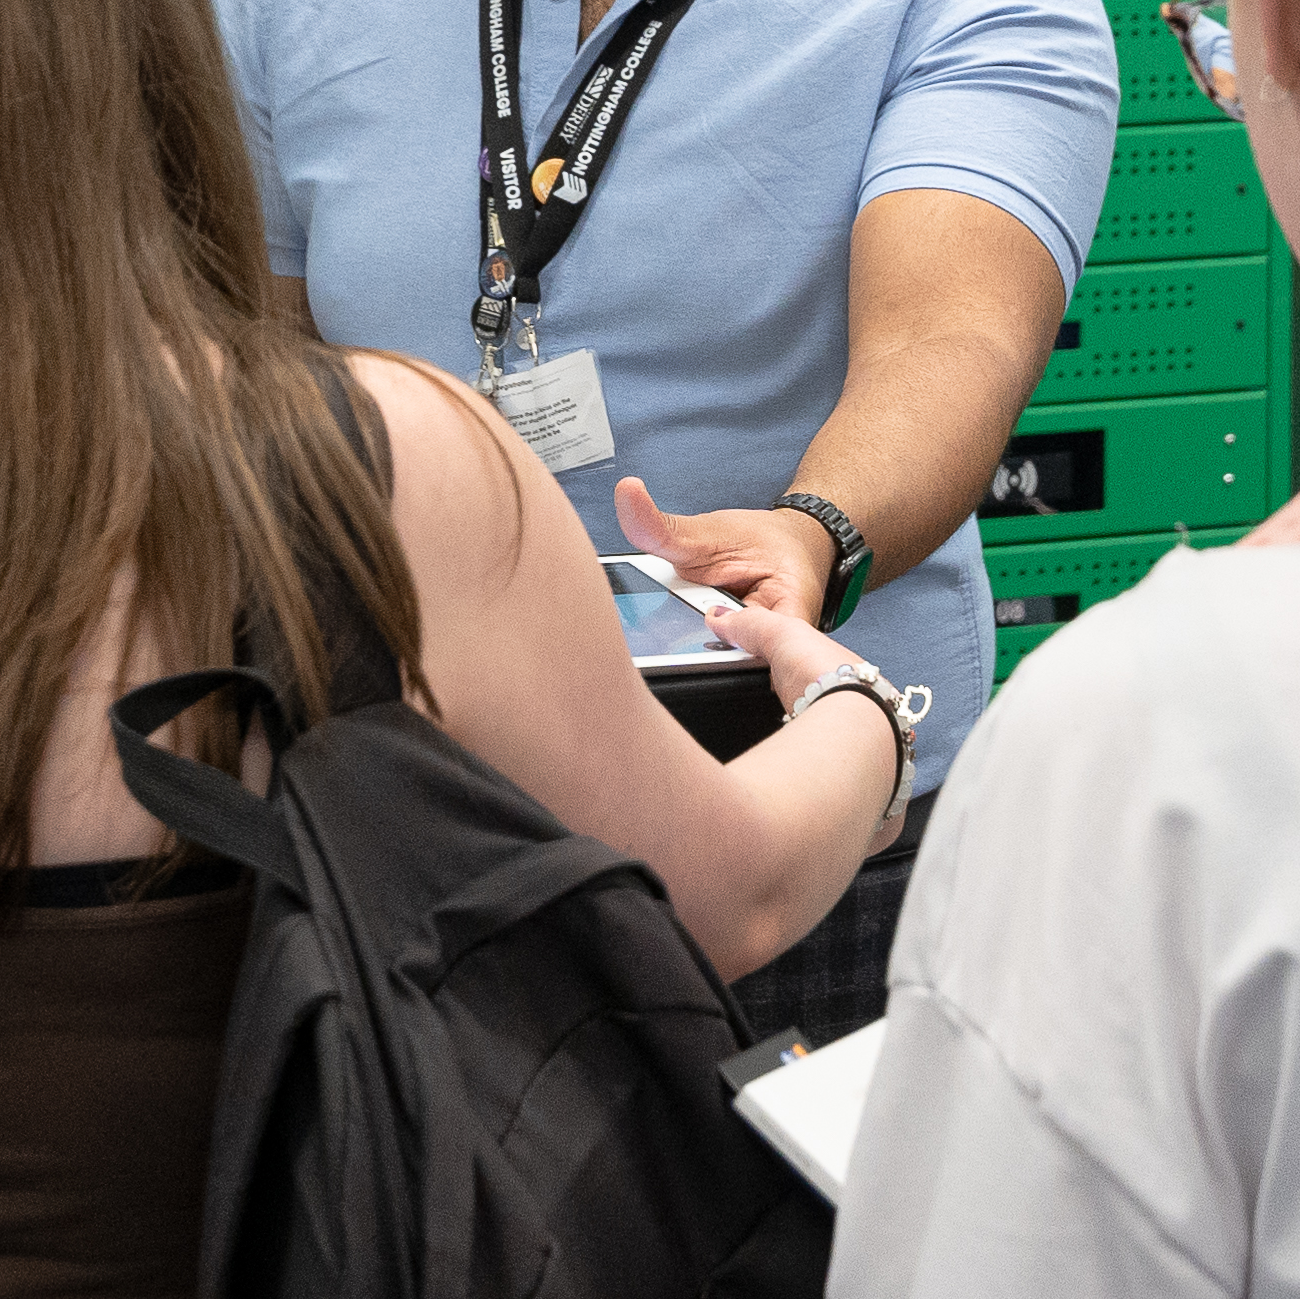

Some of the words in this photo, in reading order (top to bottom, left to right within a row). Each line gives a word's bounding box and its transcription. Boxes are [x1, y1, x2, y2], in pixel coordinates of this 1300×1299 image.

[491, 53, 512, 119] COLLEGE
[571, 79, 629, 176] NOTTINGHAM
[620, 20, 663, 81] COLLEGE
[558, 93, 594, 145] DERBY
[499, 147, 522, 211] VISITOR
